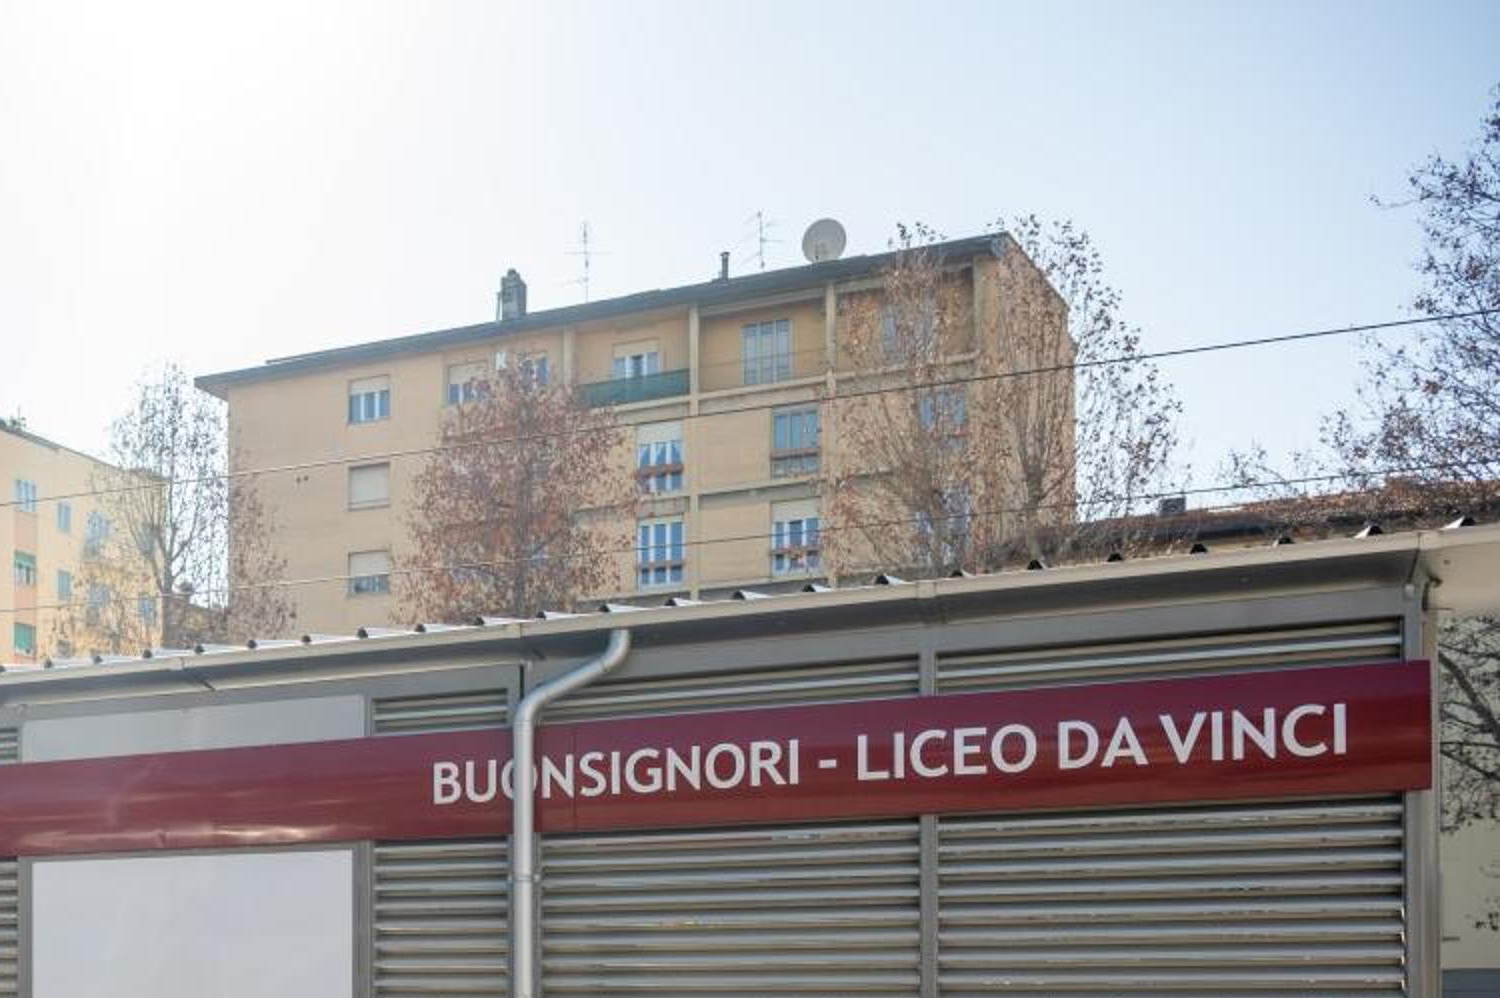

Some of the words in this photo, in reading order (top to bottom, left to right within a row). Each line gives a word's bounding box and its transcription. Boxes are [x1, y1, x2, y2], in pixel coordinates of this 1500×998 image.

[857, 720, 1037, 781] LICEO
[1058, 715, 1149, 769] DA
[1159, 703, 1347, 764] VINCI
